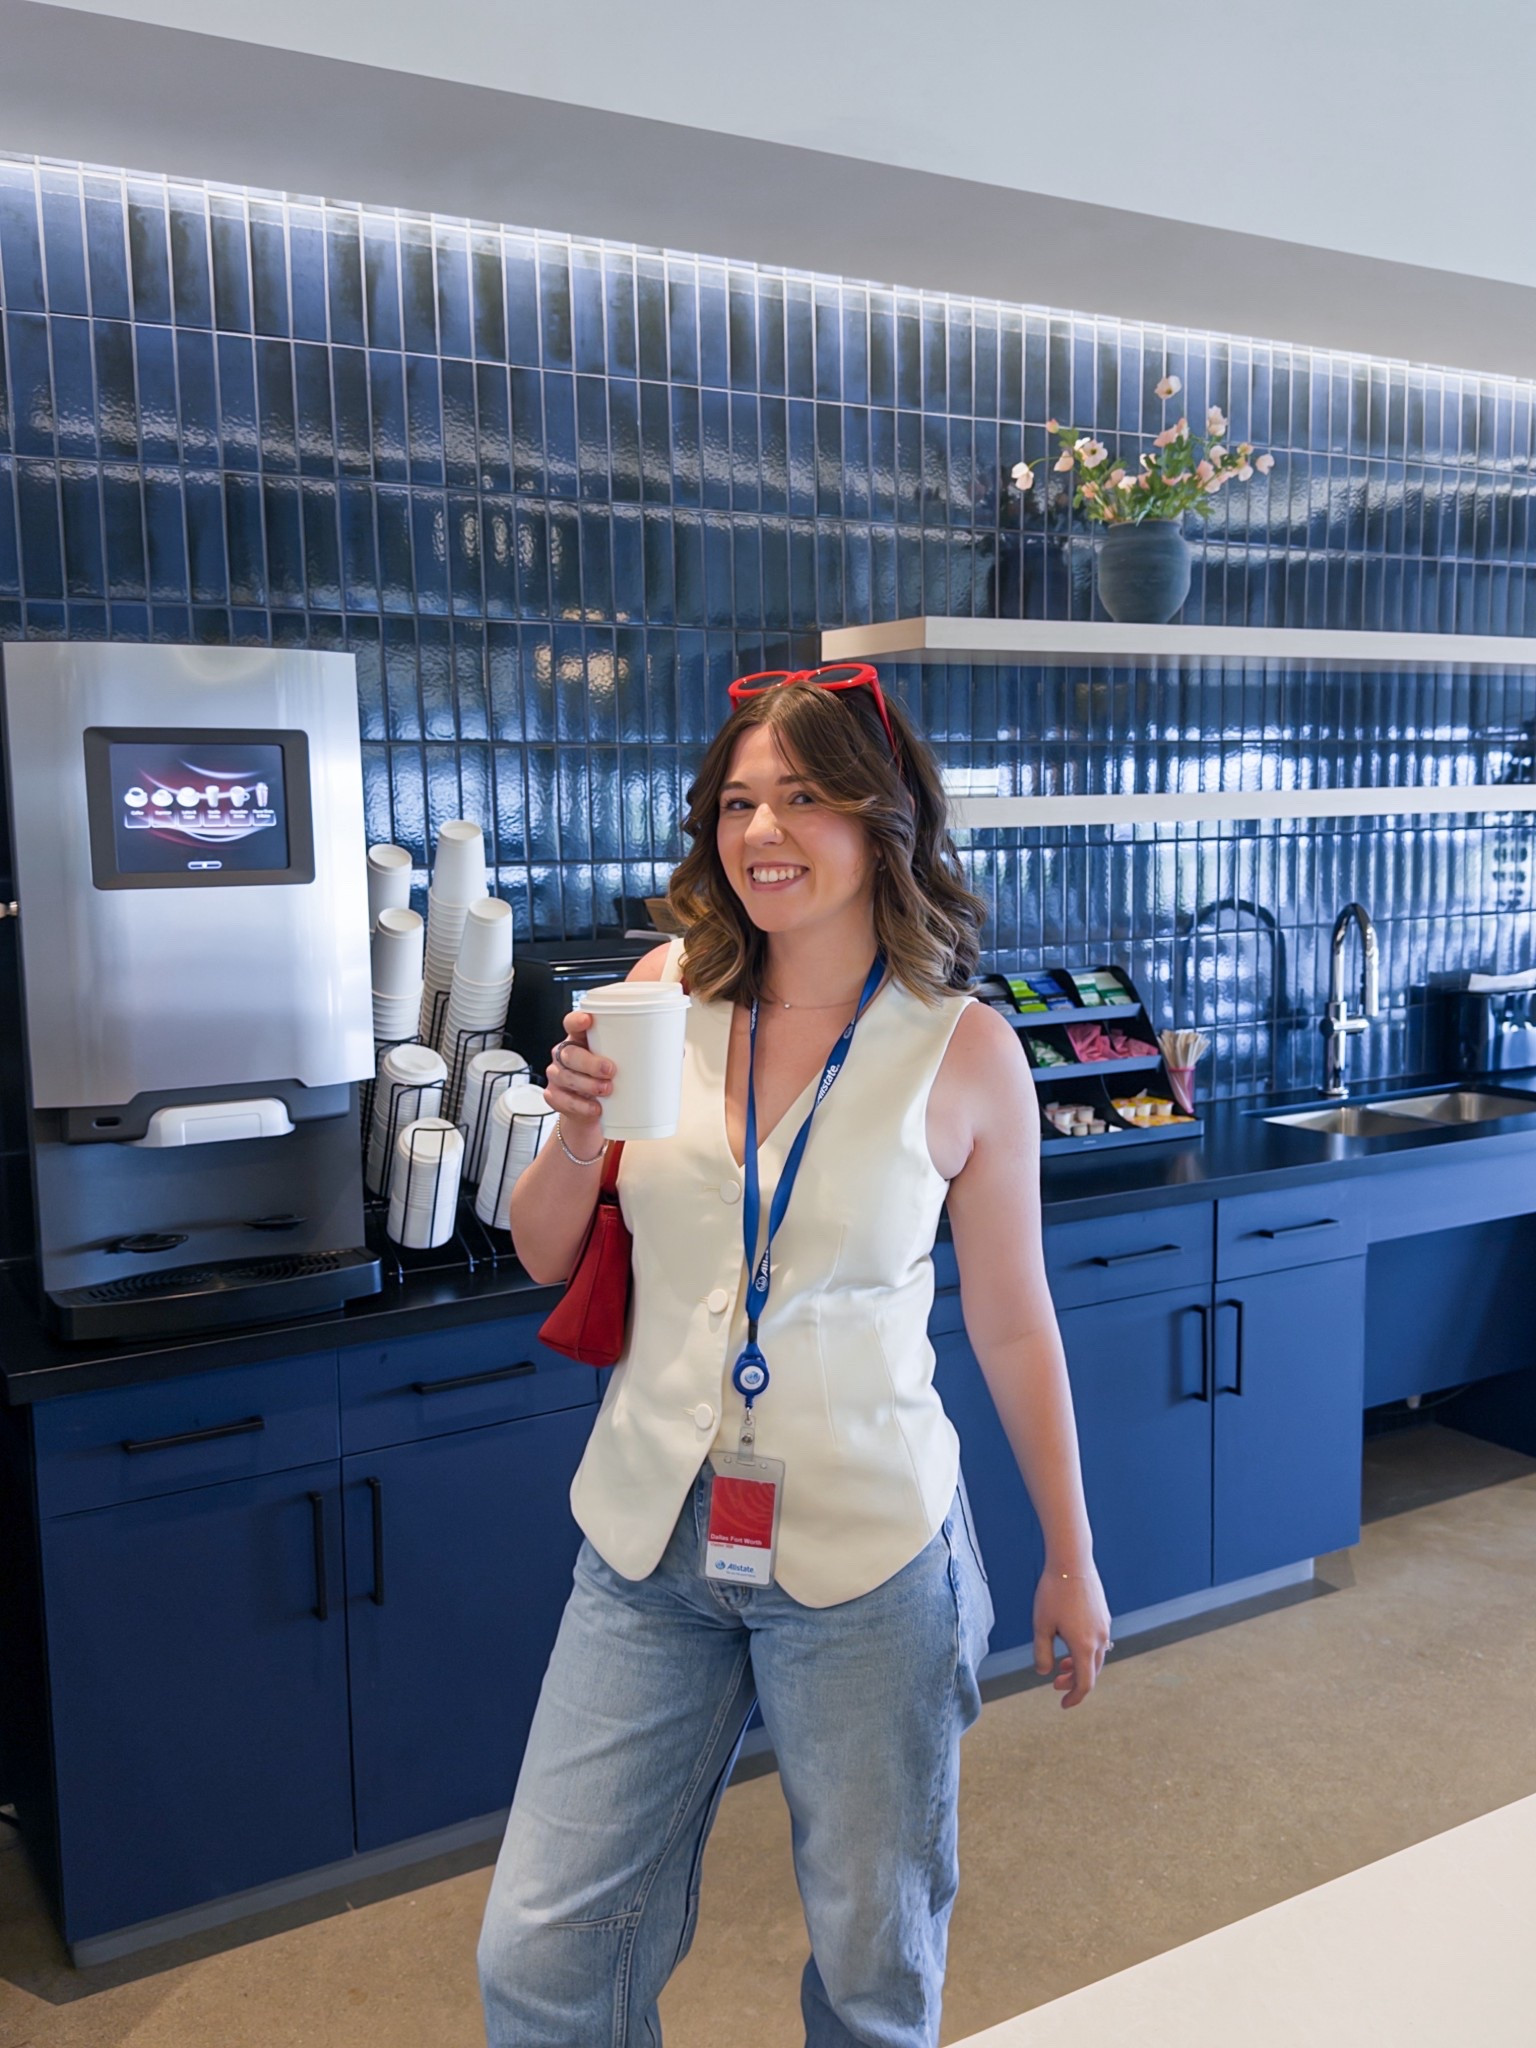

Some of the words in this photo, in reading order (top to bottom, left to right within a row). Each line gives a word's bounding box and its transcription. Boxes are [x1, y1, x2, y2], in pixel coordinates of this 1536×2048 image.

[710, 1533, 728, 1541] Dallas
[730, 1535, 743, 1543] Fort
[727, 1563, 754, 1573] Allstate
